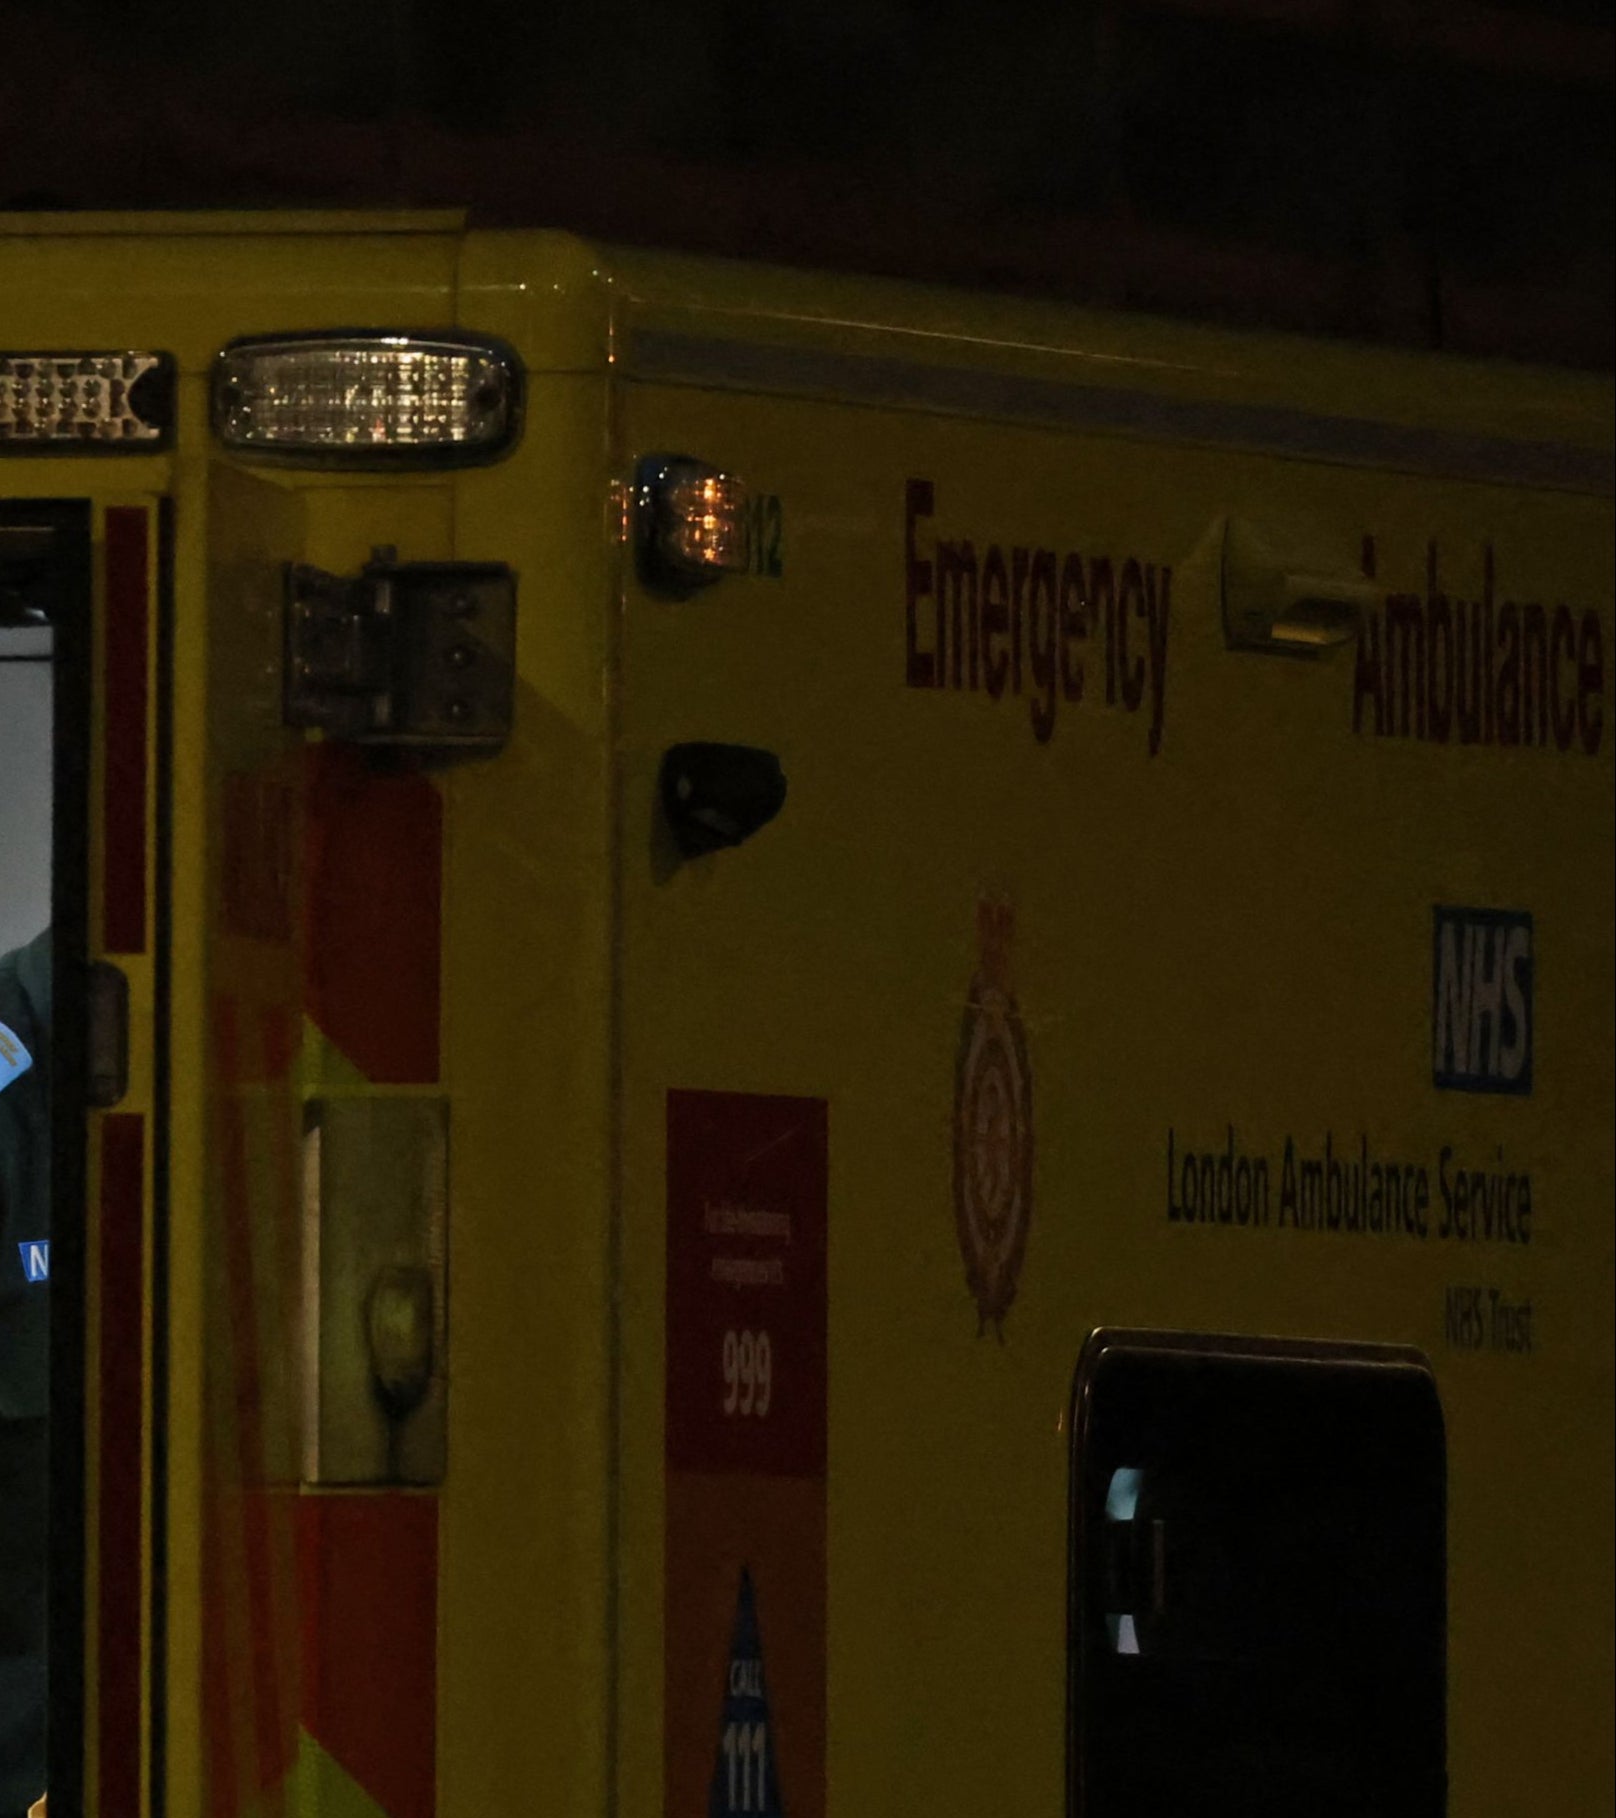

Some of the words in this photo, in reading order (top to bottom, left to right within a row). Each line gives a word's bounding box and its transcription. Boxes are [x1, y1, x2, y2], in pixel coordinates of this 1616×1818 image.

[904, 478, 1172, 756] Emergency
[1350, 534, 1604, 755] Ambulance
[1434, 919, 1532, 1081] NHS
[1167, 1120, 1270, 1227] London
[1278, 1128, 1429, 1240] Ambulance
[1437, 1143, 1532, 1245] Service
[722, 1329, 772, 1417] 999
[1445, 1285, 1484, 1351] NHS
[1487, 1287, 1533, 1353] Trust
[722, 1721, 766, 1813] 111
